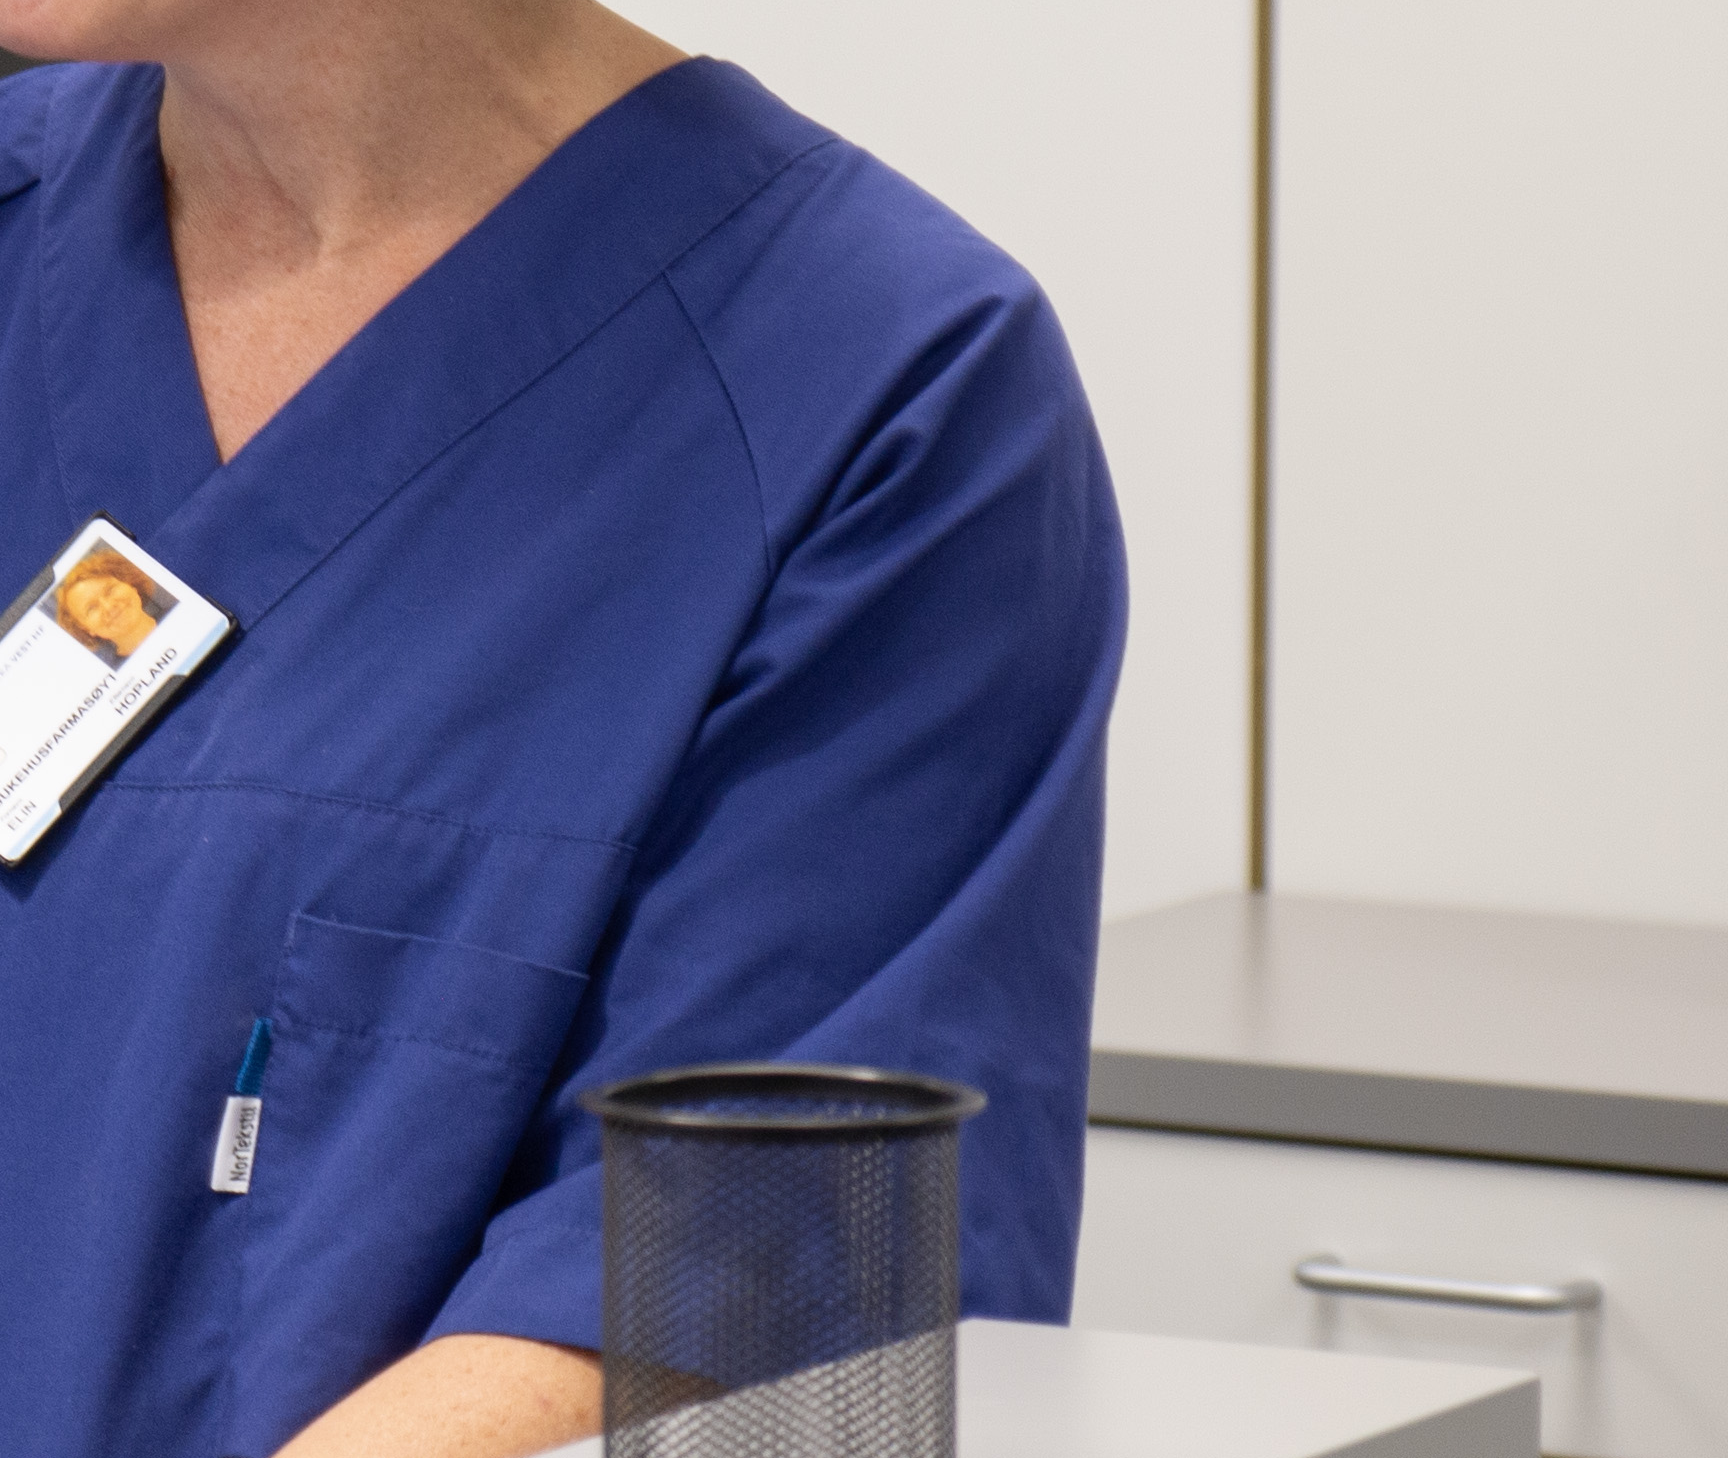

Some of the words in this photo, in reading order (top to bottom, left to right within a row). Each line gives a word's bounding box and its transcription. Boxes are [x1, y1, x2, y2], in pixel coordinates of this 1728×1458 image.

[10, 640, 34, 664] VEST
[114, 646, 179, 716] HOPLAND
[7, 799, 37, 832] ELIN
